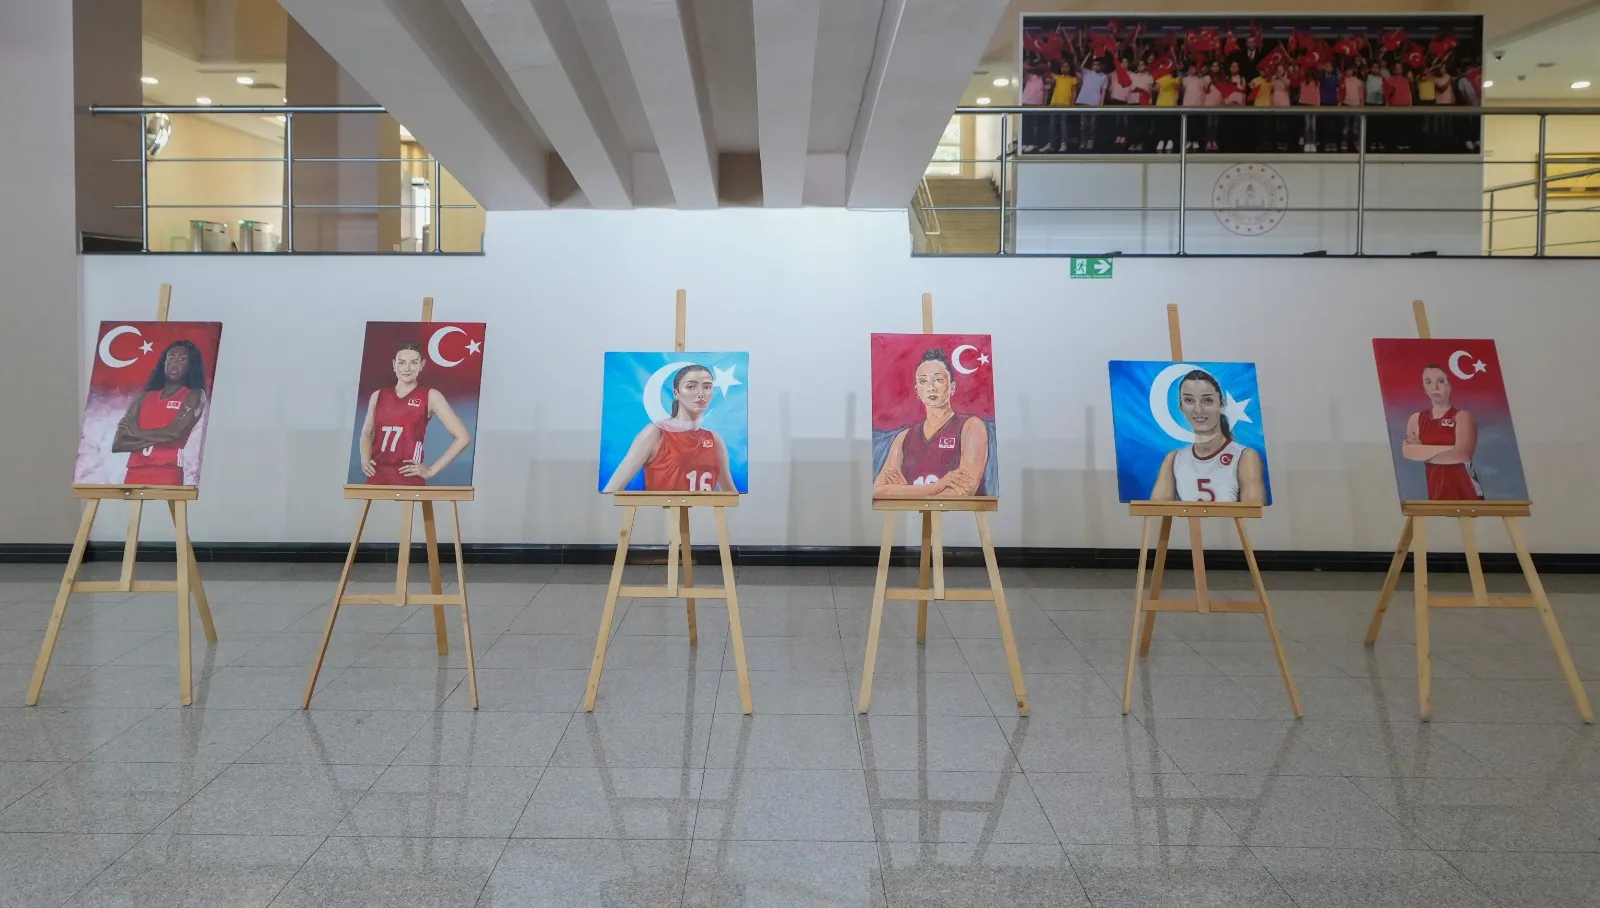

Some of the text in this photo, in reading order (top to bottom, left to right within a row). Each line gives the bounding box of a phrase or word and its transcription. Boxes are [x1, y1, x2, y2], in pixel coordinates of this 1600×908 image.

[381, 426, 404, 453] 77
[685, 470, 713, 492] 16
[1197, 478, 1216, 502] 5
